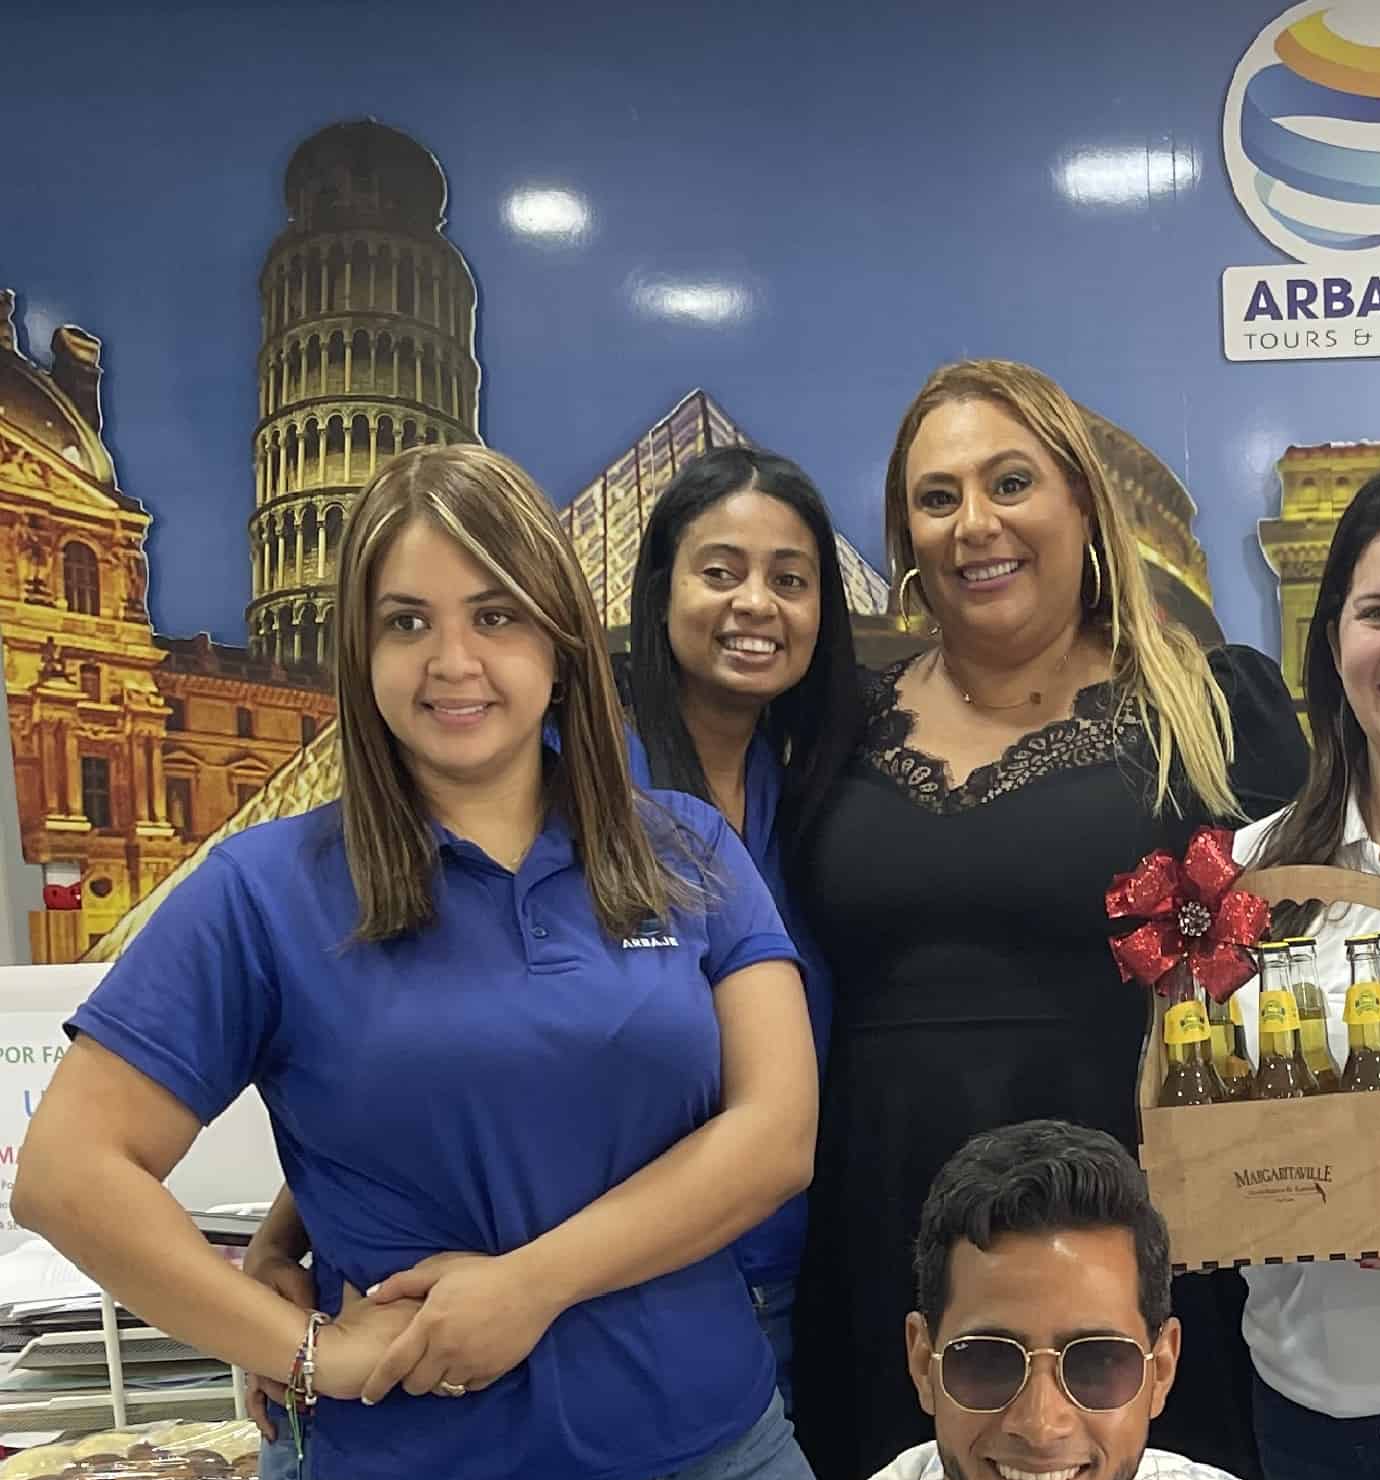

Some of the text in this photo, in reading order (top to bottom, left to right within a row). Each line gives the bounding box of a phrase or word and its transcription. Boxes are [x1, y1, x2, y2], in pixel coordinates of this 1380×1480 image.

[1244, 329, 1338, 351] TOURS
[622, 936, 679, 949] ARBAJE
[1233, 1165, 1334, 1189] MARGARITAVILLE
